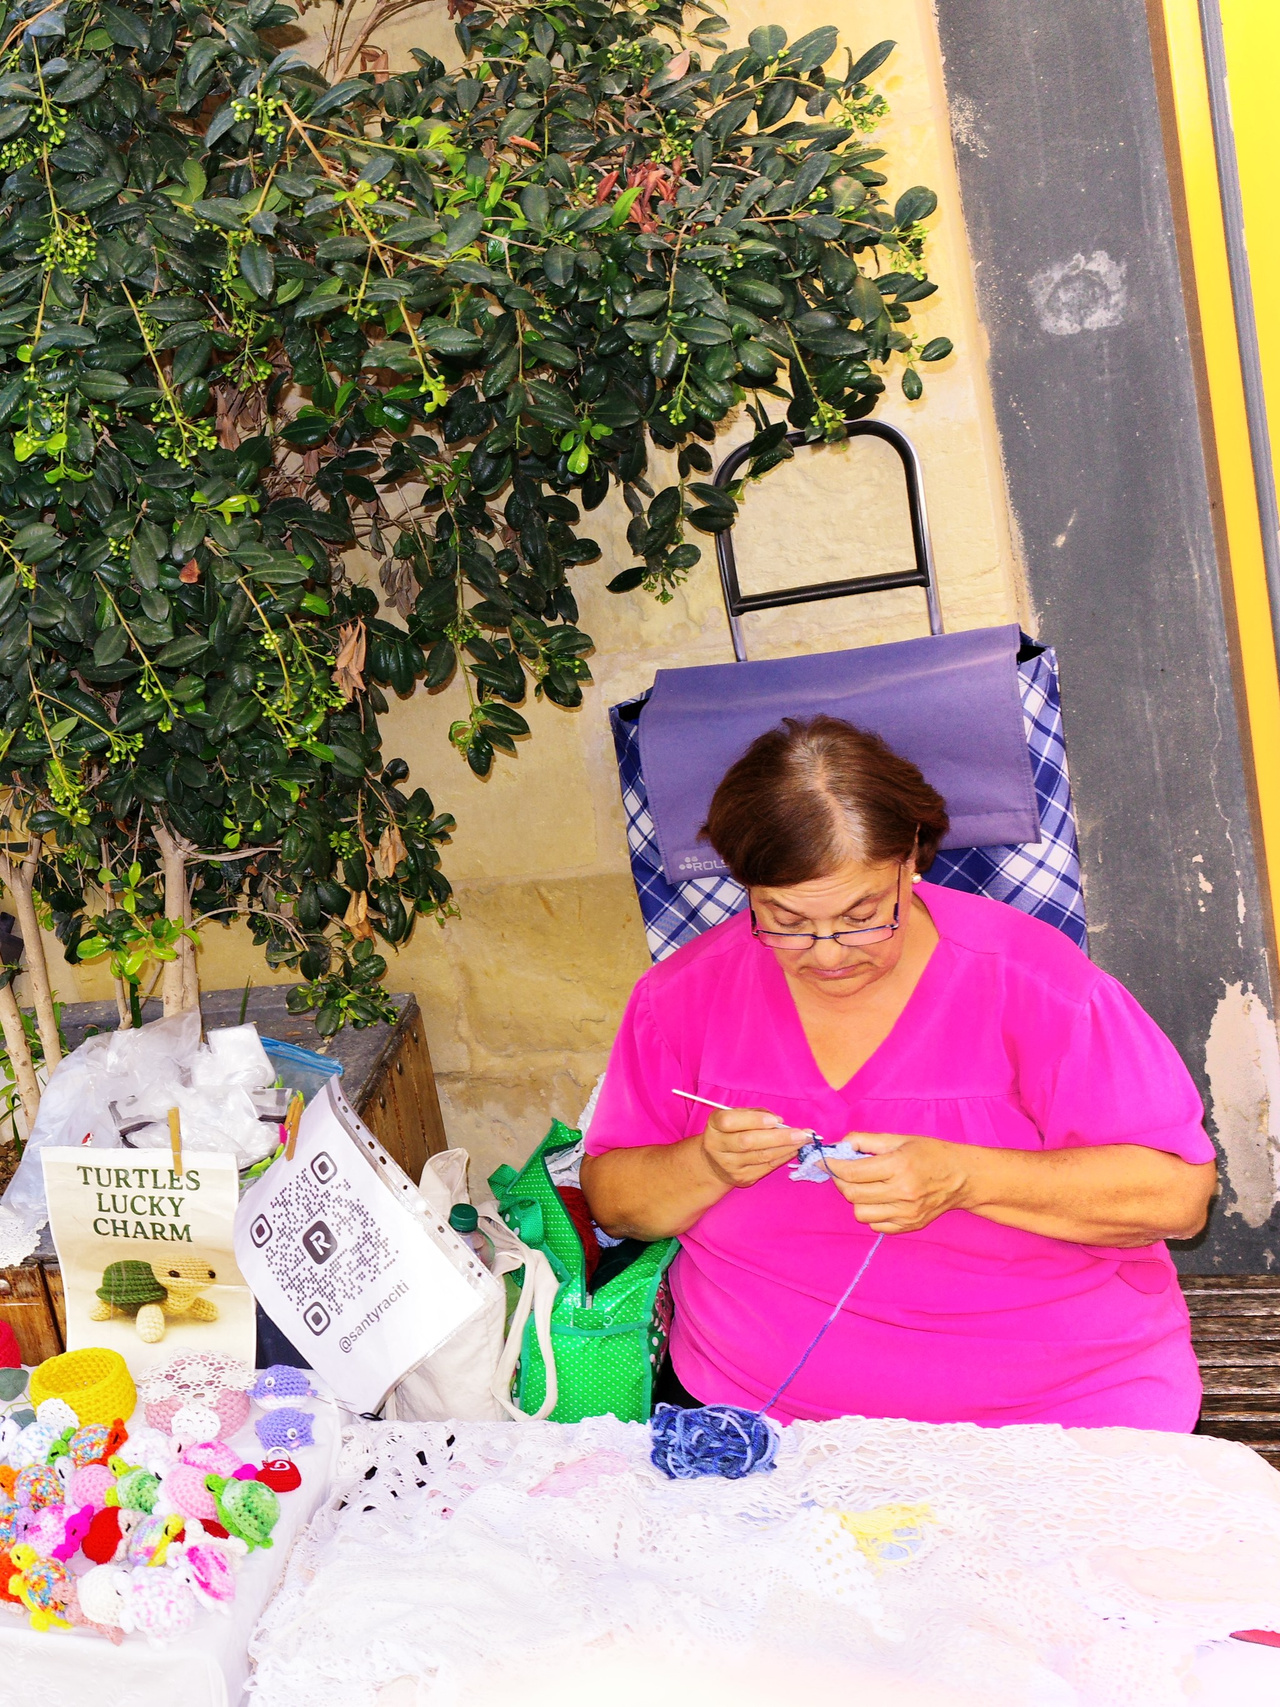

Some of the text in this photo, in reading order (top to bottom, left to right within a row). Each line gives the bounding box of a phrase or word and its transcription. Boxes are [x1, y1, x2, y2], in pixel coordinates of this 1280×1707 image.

[77, 1165, 200, 1191] TURTLES
[96, 1192, 185, 1217] LUCKY
[93, 1217, 193, 1242] CHARM
[309, 1230, 332, 1256] R
[339, 1279, 410, 1353] @santyraciti
